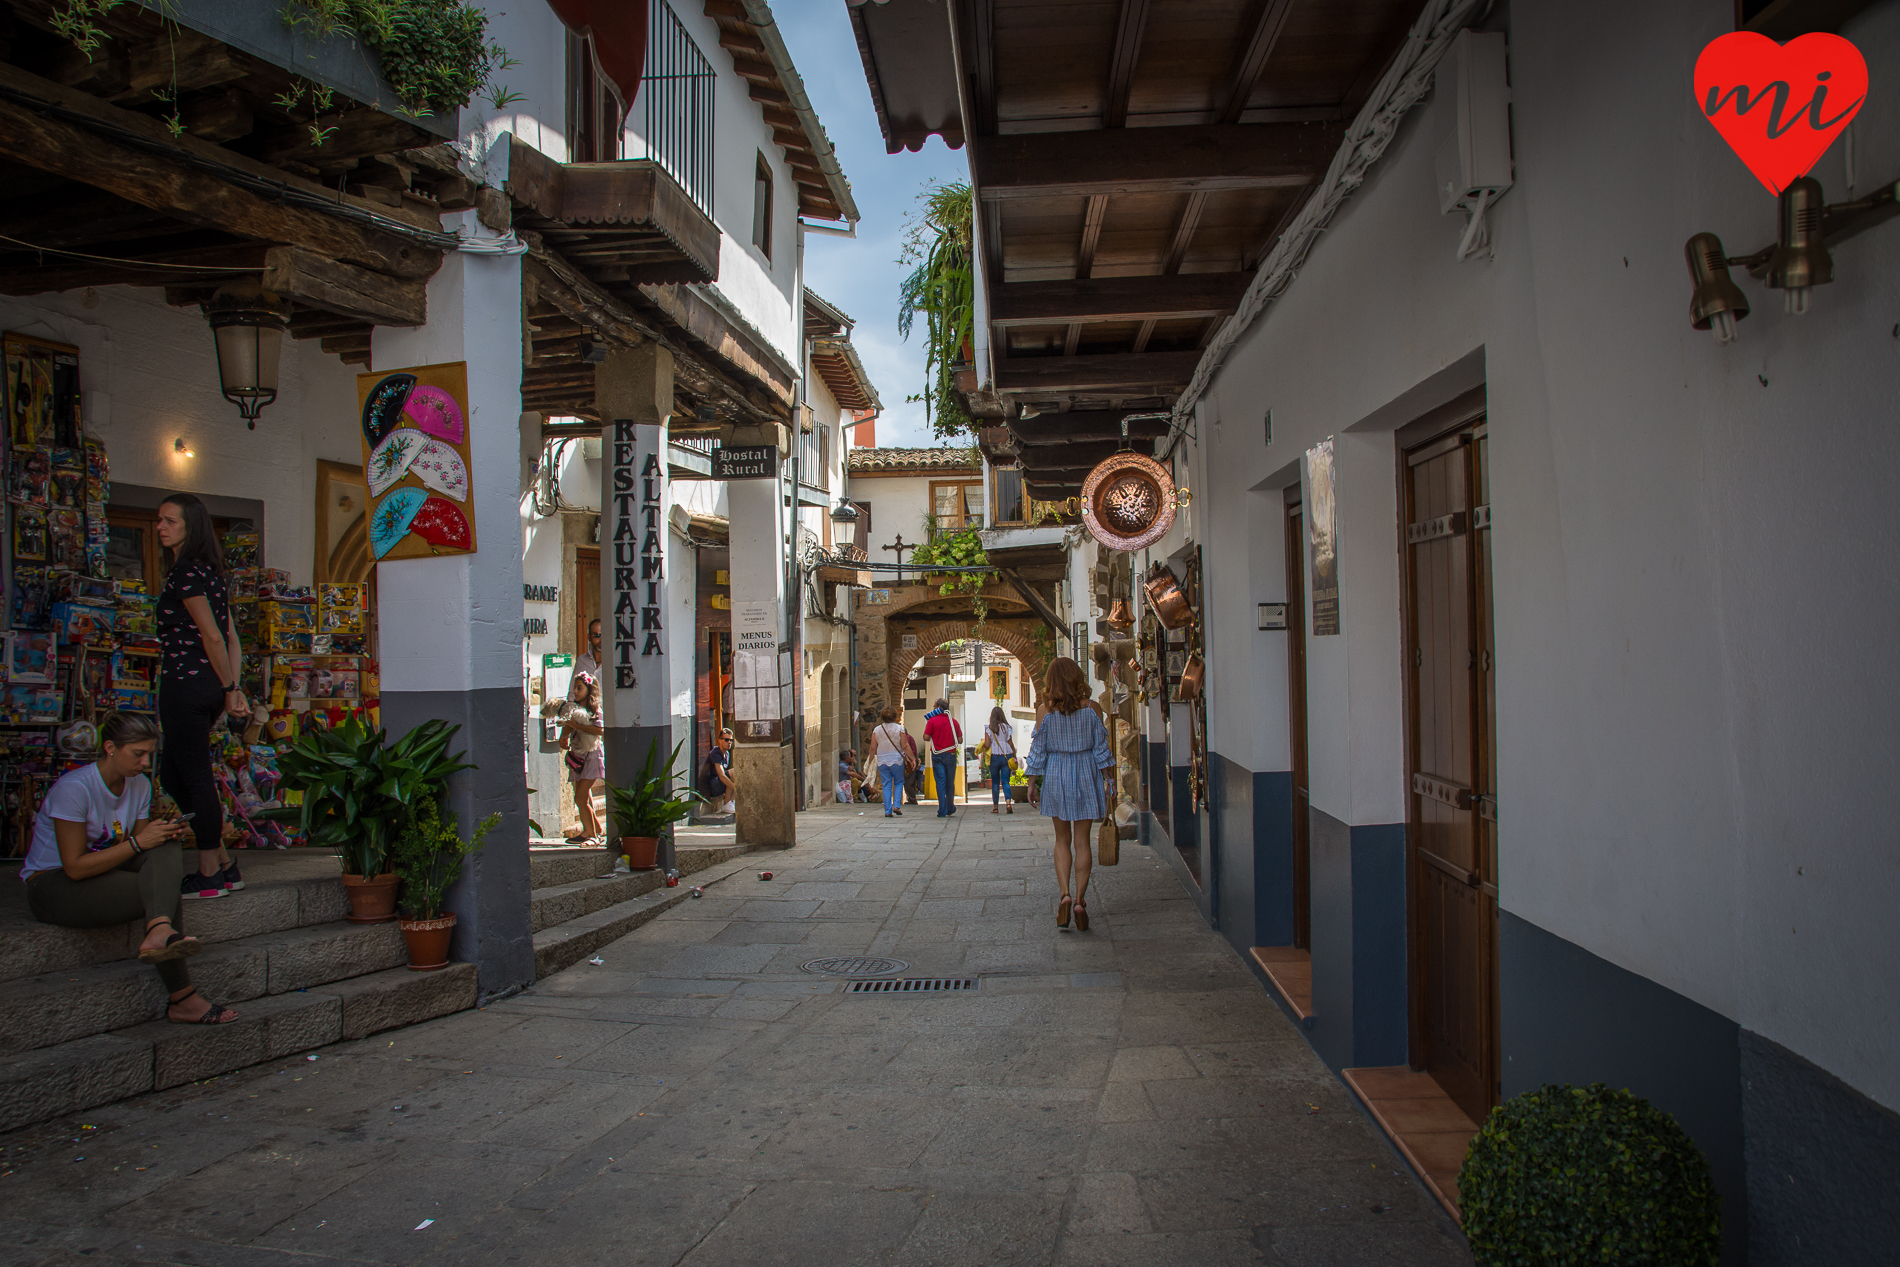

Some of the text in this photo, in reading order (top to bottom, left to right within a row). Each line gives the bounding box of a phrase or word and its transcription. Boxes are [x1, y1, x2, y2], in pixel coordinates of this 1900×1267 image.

[718, 449, 768, 463] Hostal
[721, 463, 765, 476] Rural
[613, 418, 637, 689] RESTAURANTE
[641, 453, 664, 656] ALTAMIRA
[740, 631, 772, 640] MENUS
[738, 641, 776, 650] DIARIOS
